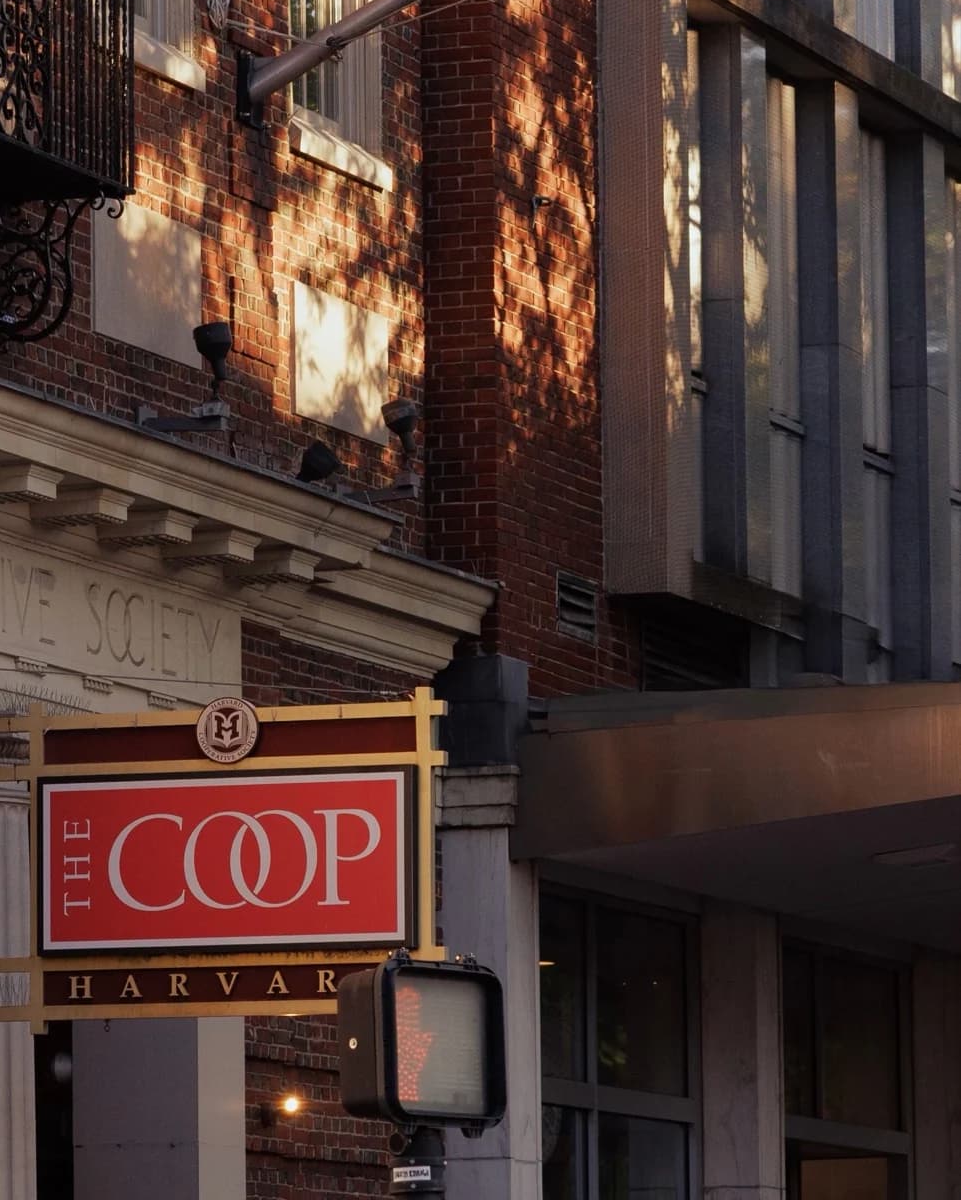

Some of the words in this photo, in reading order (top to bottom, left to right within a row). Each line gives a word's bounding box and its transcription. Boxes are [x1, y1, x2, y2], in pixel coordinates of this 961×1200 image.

[86, 583, 223, 688] SOCIETY
[63, 818, 91, 917] THE
[107, 808, 382, 913] COOP
[68, 969, 338, 999] HARVAR
